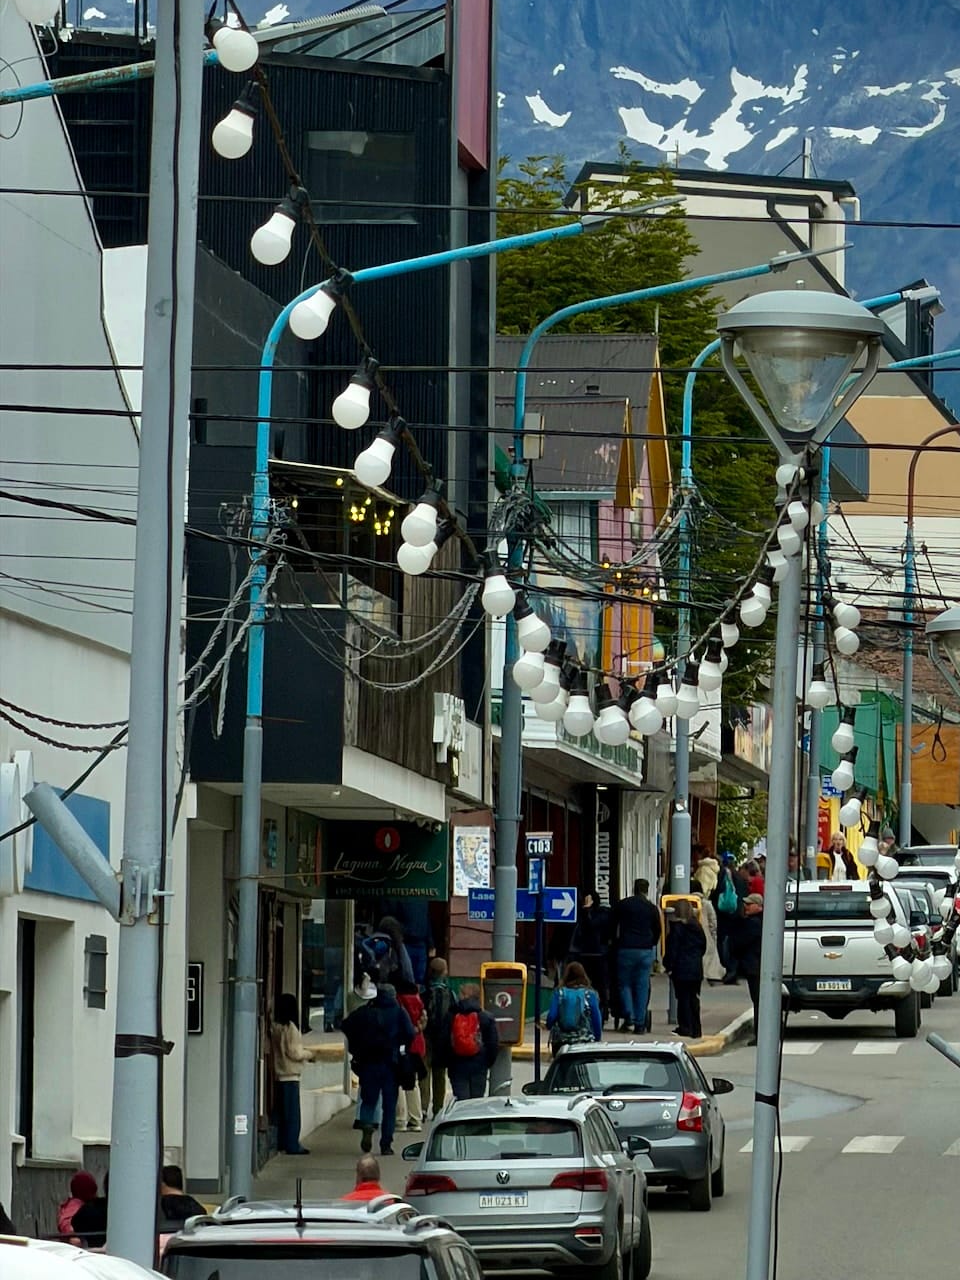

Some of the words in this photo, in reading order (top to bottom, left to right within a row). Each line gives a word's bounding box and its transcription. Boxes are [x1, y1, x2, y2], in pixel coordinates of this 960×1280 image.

[528, 840, 551, 853] C103
[333, 852, 383, 881] Laguna
[388, 854, 442, 880] Negra
[386, 887, 440, 896] ARTESANALES
[470, 910, 488, 918] 200
